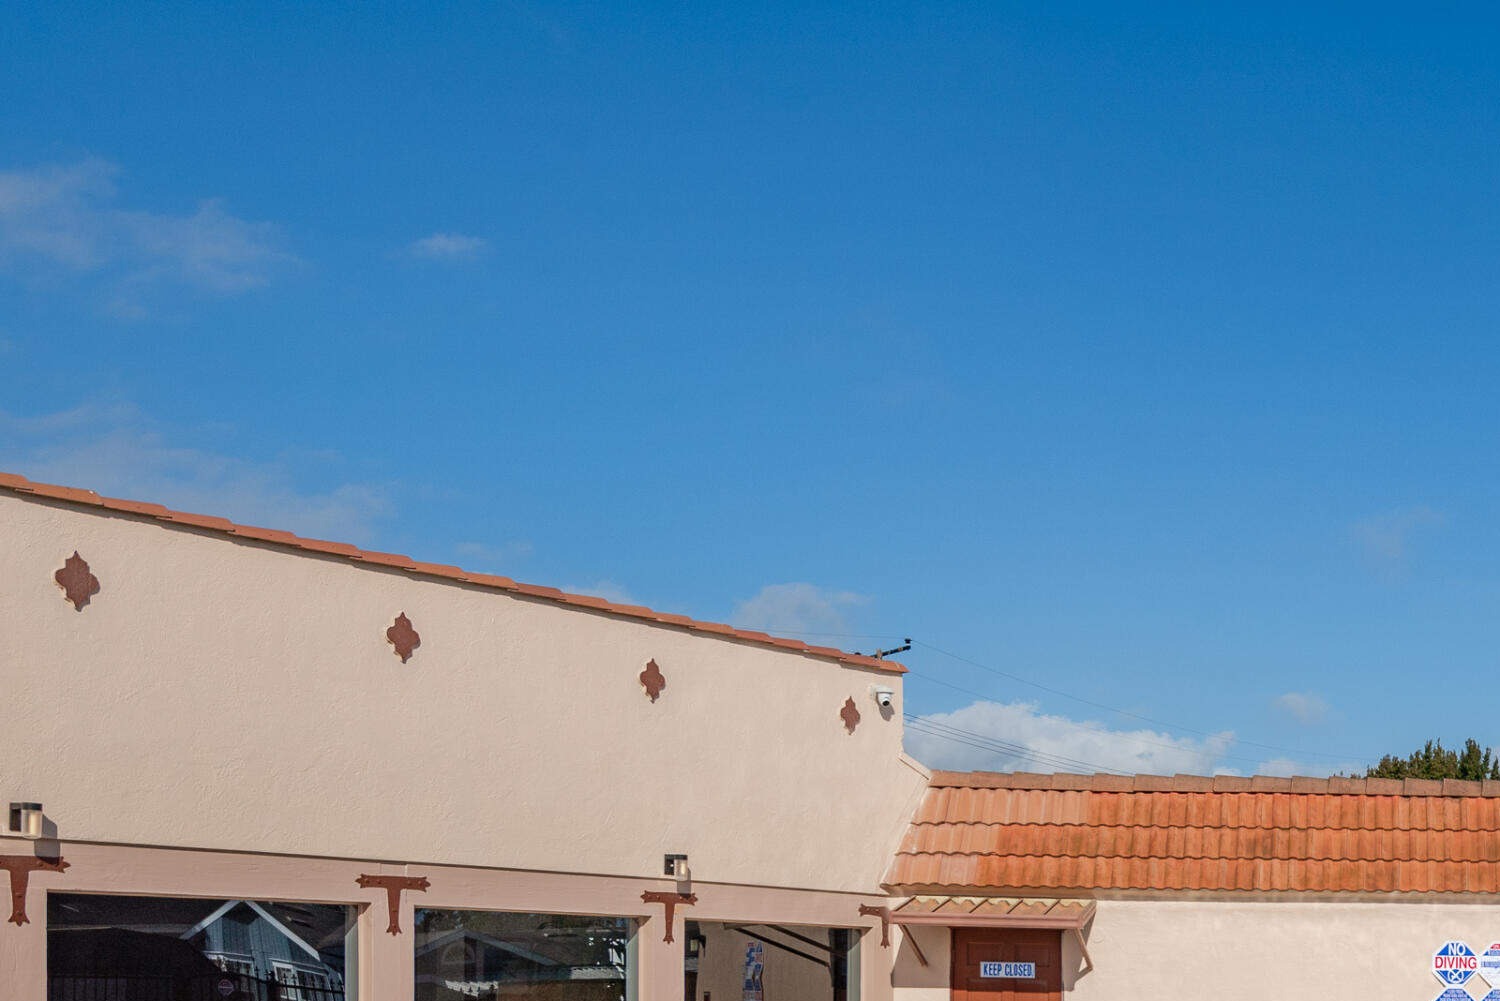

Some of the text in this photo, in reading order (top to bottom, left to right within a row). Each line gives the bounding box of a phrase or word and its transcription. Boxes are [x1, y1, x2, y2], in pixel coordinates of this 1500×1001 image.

[1448, 942, 1465, 955] NO
[1434, 956, 1477, 969] DIVING
[983, 963, 1032, 976] KEEP CLOSED
